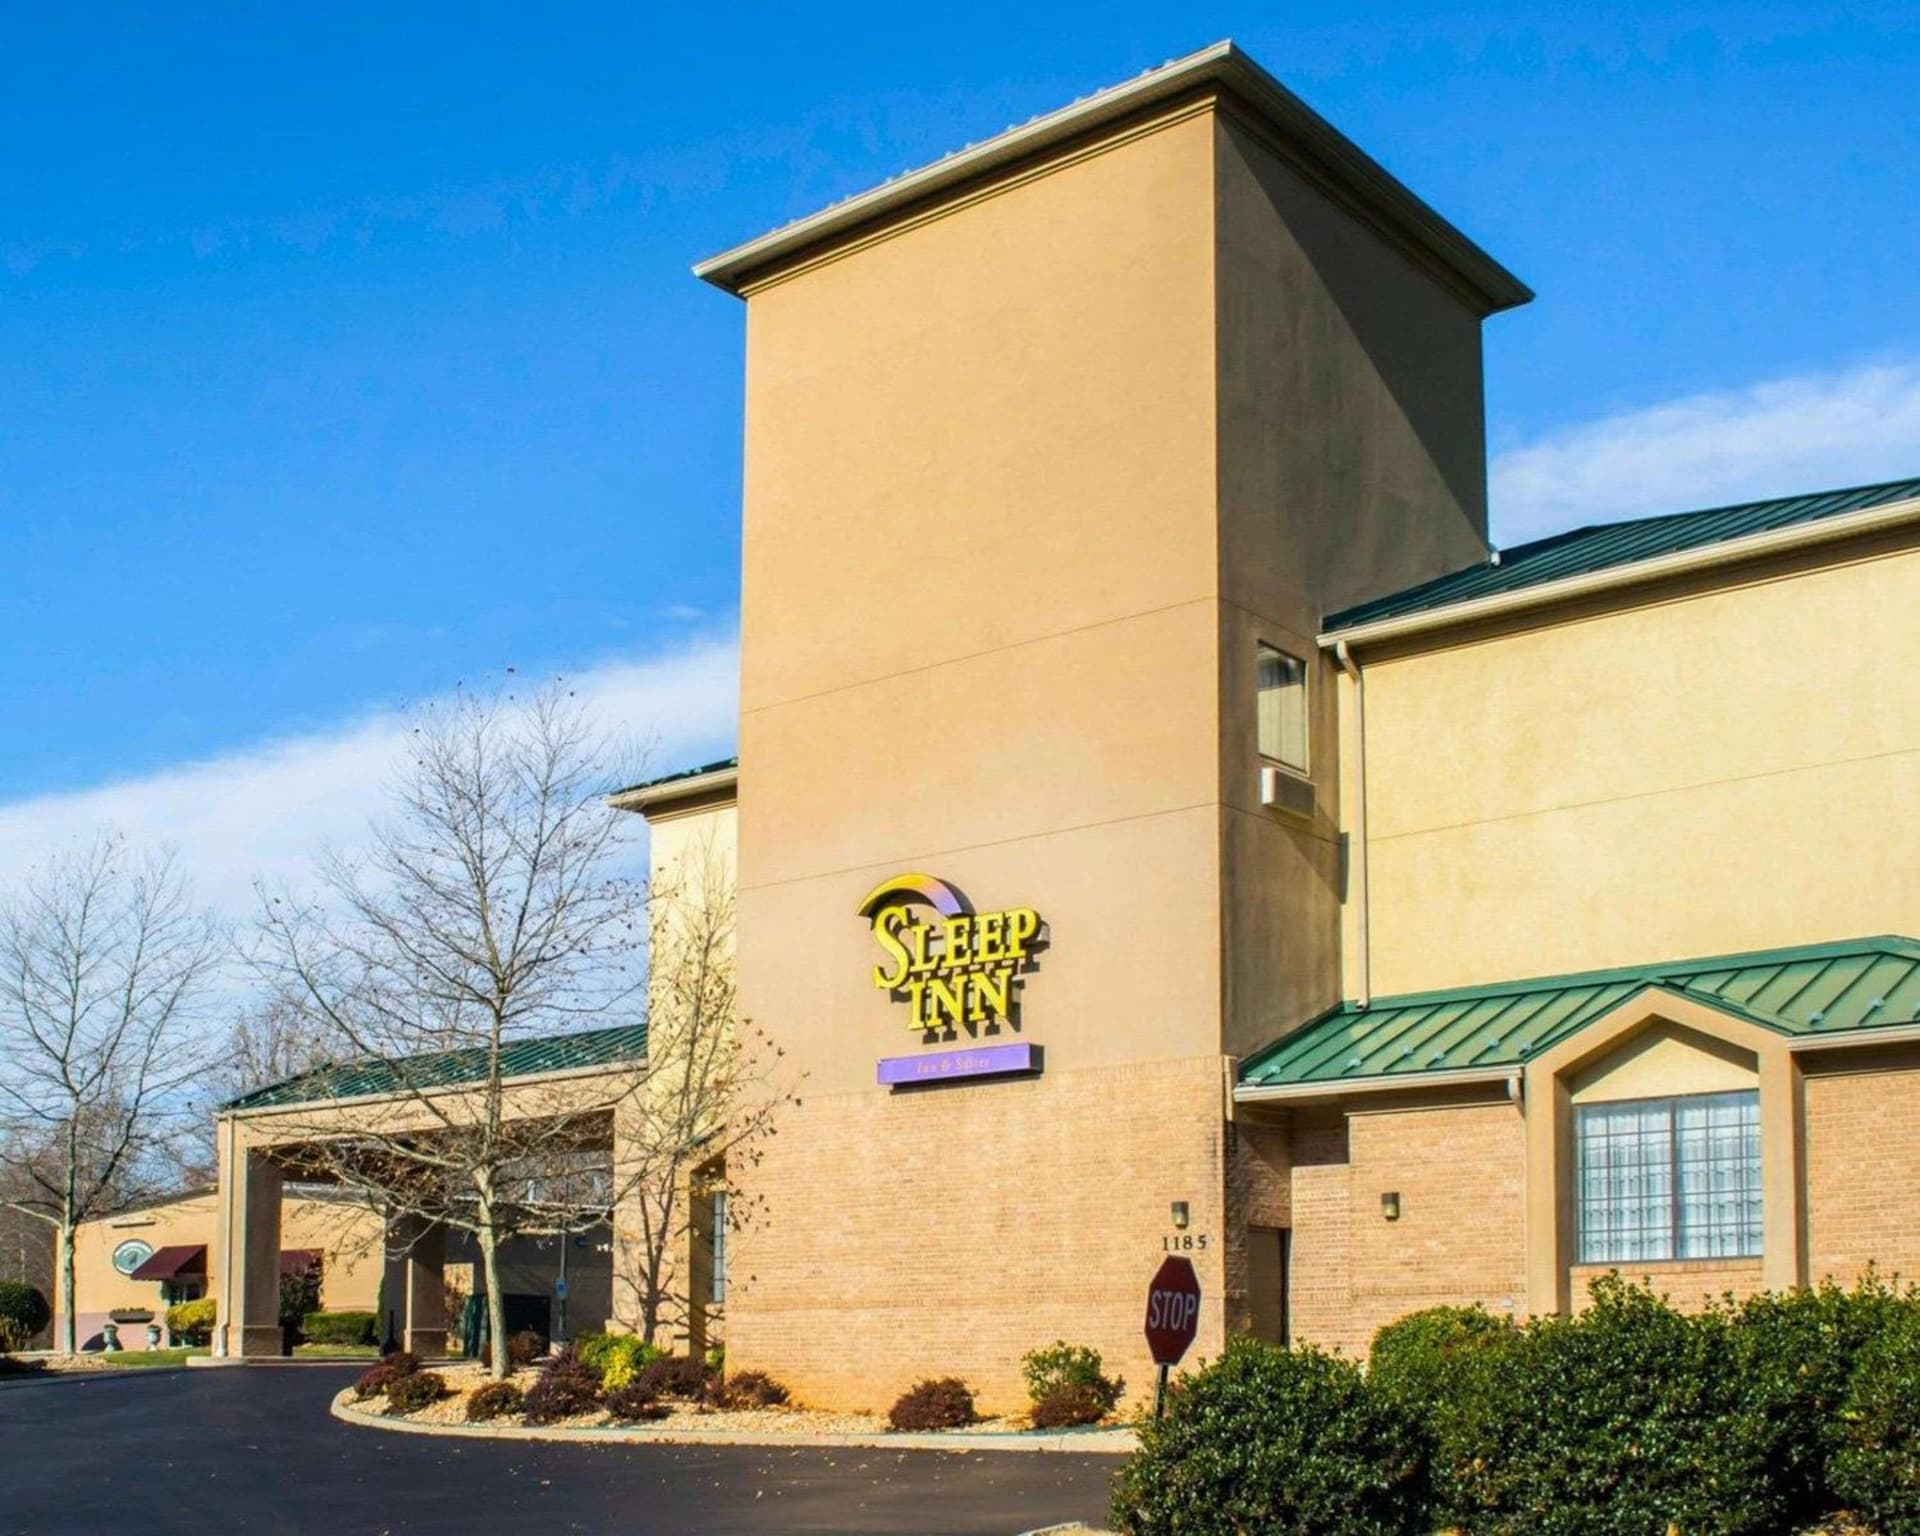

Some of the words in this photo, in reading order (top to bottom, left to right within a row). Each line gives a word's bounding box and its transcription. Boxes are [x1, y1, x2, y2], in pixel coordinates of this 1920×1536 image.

[873, 906, 1037, 989] SLEEP
[908, 967, 1012, 1030] INN
[1162, 1235, 1207, 1251] 1185
[1151, 1290, 1197, 1330] STOP
